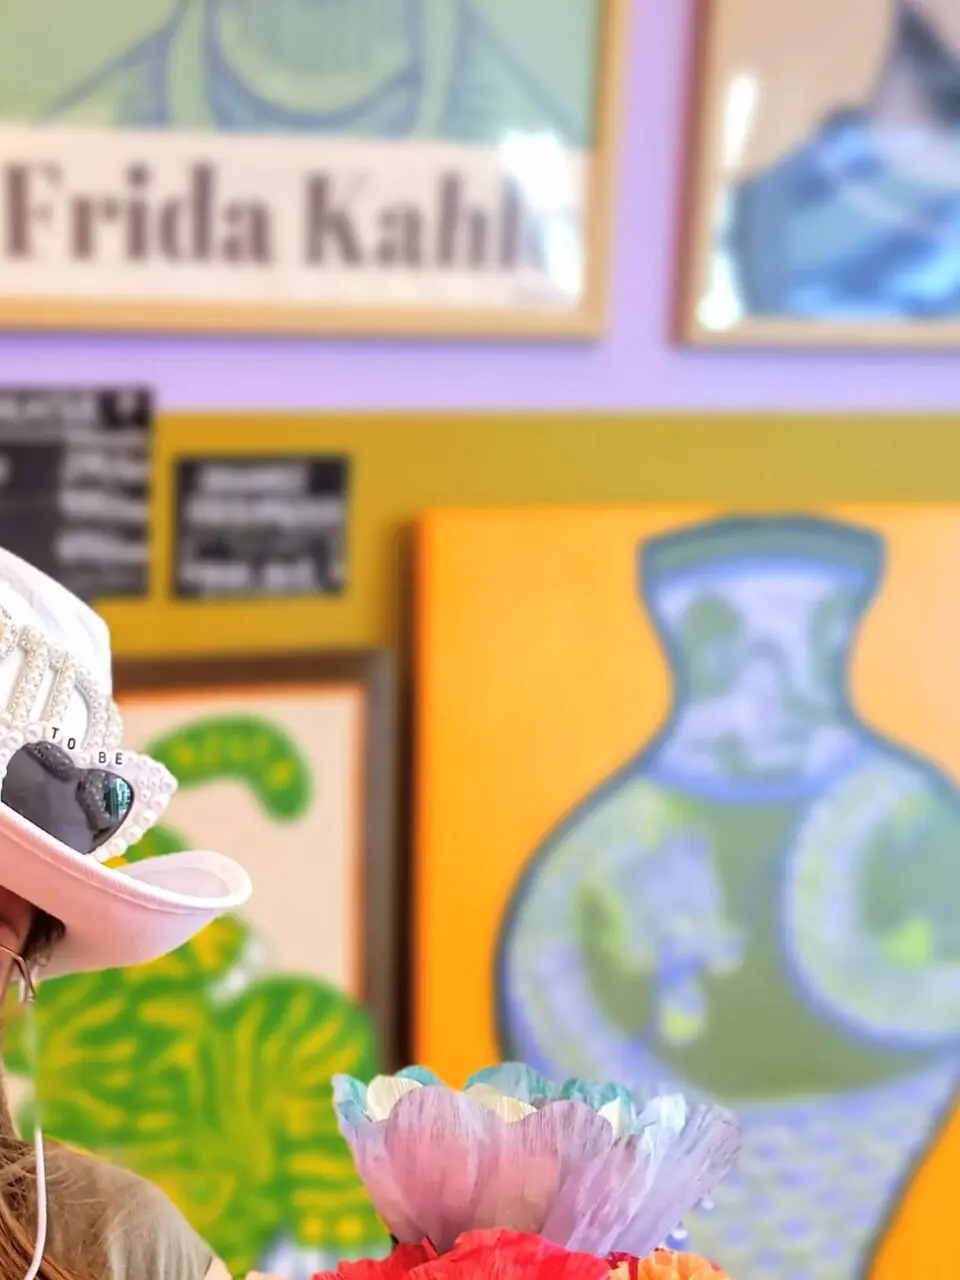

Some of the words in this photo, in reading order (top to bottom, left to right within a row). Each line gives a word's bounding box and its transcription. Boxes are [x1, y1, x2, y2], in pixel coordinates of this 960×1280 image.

[2, 158, 272, 268] Frida
[303, 168, 544, 272] Kahl
[50, 726, 77, 750] TO
[98, 751, 123, 765] BE
